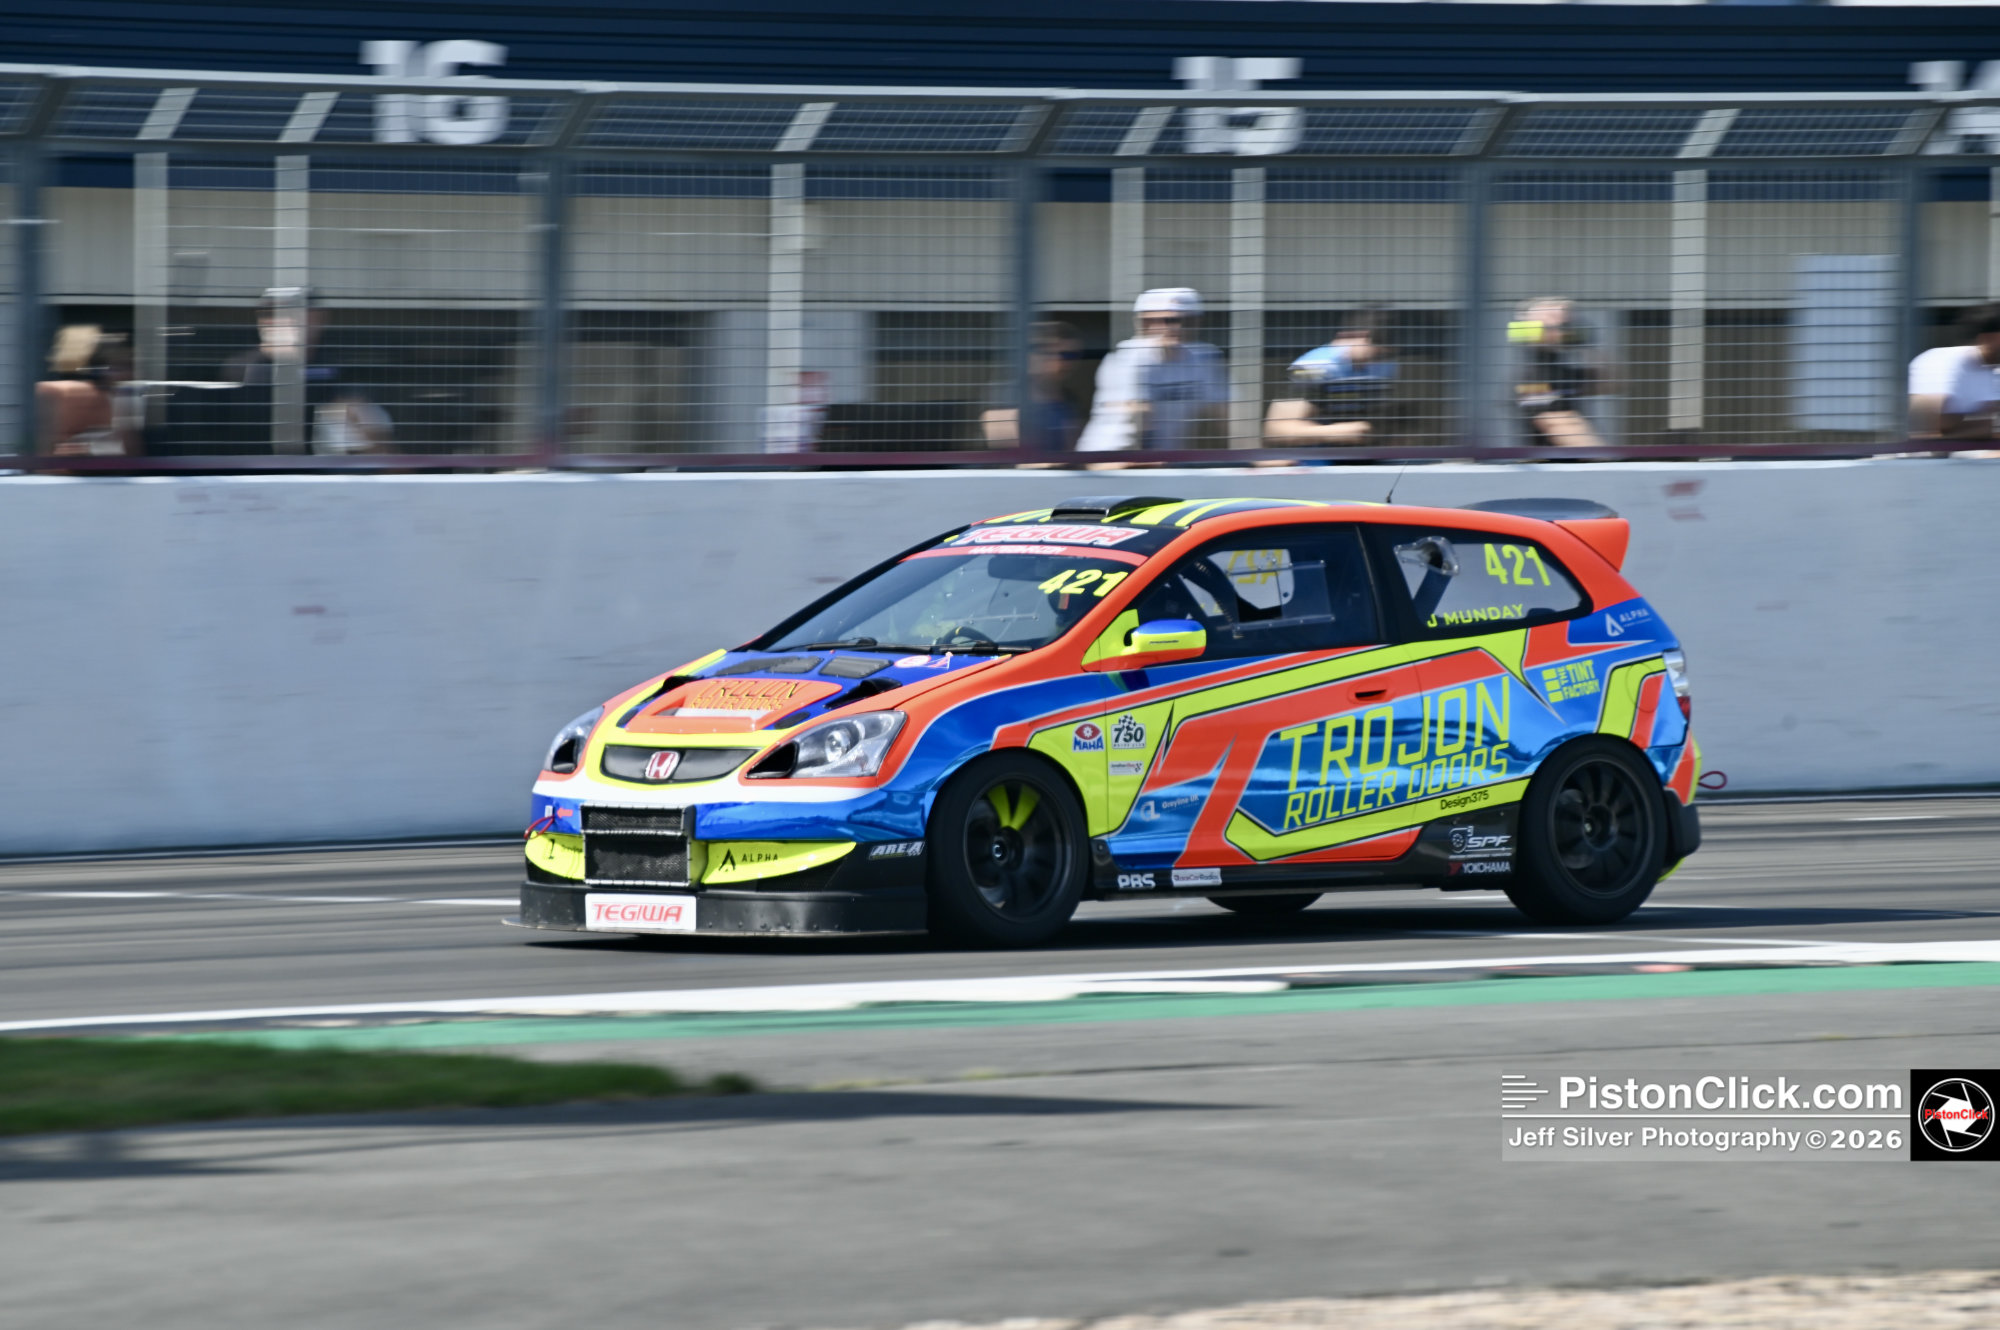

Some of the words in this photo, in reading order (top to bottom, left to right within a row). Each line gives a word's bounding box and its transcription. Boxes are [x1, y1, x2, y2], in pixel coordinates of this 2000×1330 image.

[358, 40, 510, 144] 16
[1171, 56, 1304, 156] 15
[1484, 543, 1551, 586] 421
[1038, 569, 1128, 597] 421
[1427, 613, 1438, 628] J
[1443, 603, 1523, 626] MUNDAY
[1619, 608, 1649, 624] ALPHA
[1566, 659, 1595, 683] TINT
[1562, 679, 1600, 699] FACTORY
[1073, 736, 1104, 750] MAHA
[1113, 727, 1144, 743] 750
[1280, 676, 1510, 792] TROJON
[1284, 769, 1397, 829] ROLLER
[1406, 742, 1509, 799] DOORS
[1440, 790, 1489, 810] Design375
[871, 841, 924, 856] AREA
[1467, 835, 1512, 848] SPF
[741, 853, 778, 862] ALPHA
[1462, 861, 1511, 874] YOKOHAMA
[594, 903, 683, 922] TEGIWA
